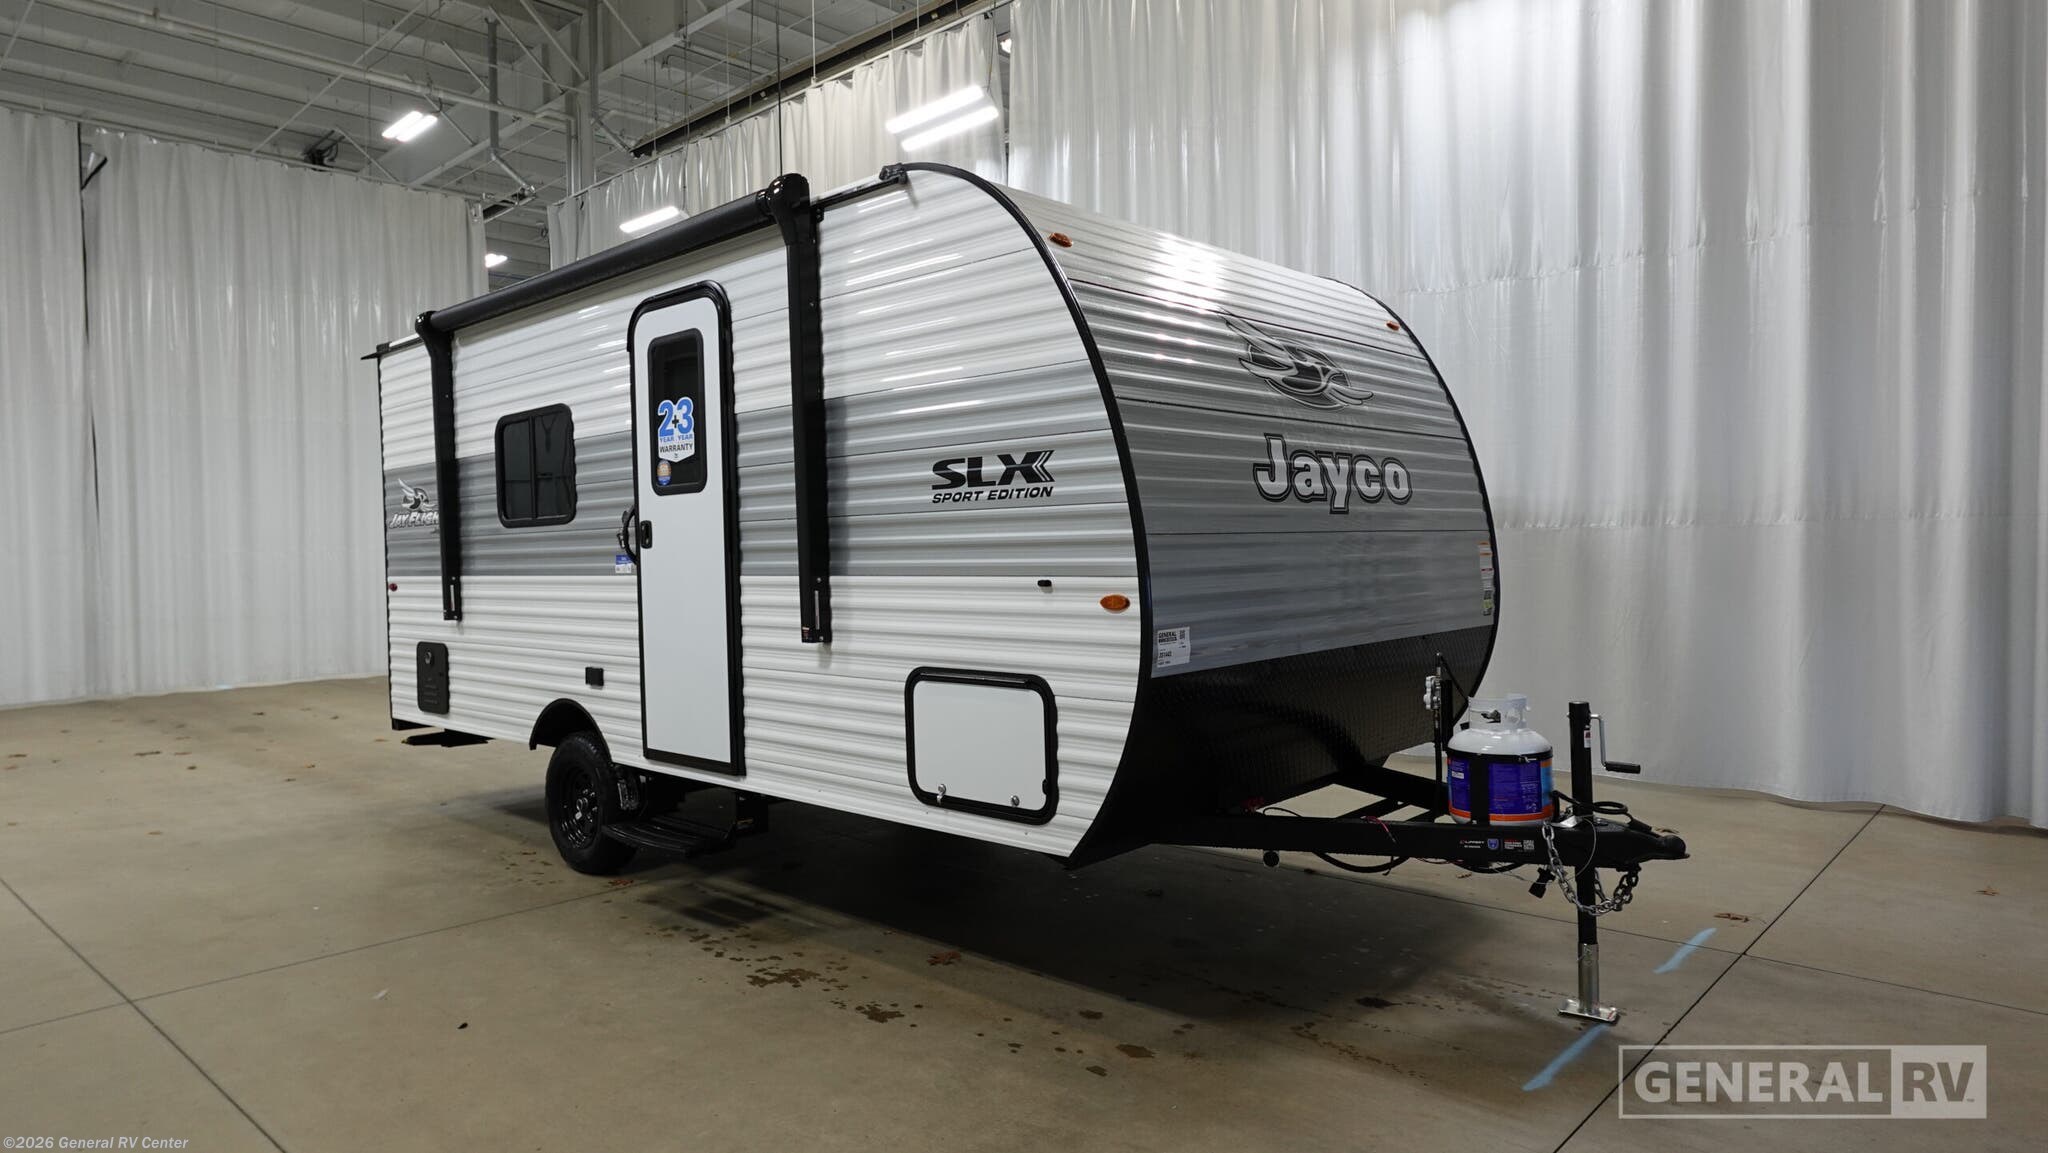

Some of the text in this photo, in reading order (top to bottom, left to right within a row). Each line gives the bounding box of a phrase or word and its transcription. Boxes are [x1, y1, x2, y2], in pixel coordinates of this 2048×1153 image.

[660, 443, 693, 453] WARRANTY
[932, 450, 1055, 490] SLX
[1253, 433, 1413, 514] Jayco
[932, 486, 1054, 504] SPORT EDITION
[389, 511, 440, 529] JAY FLIGH
